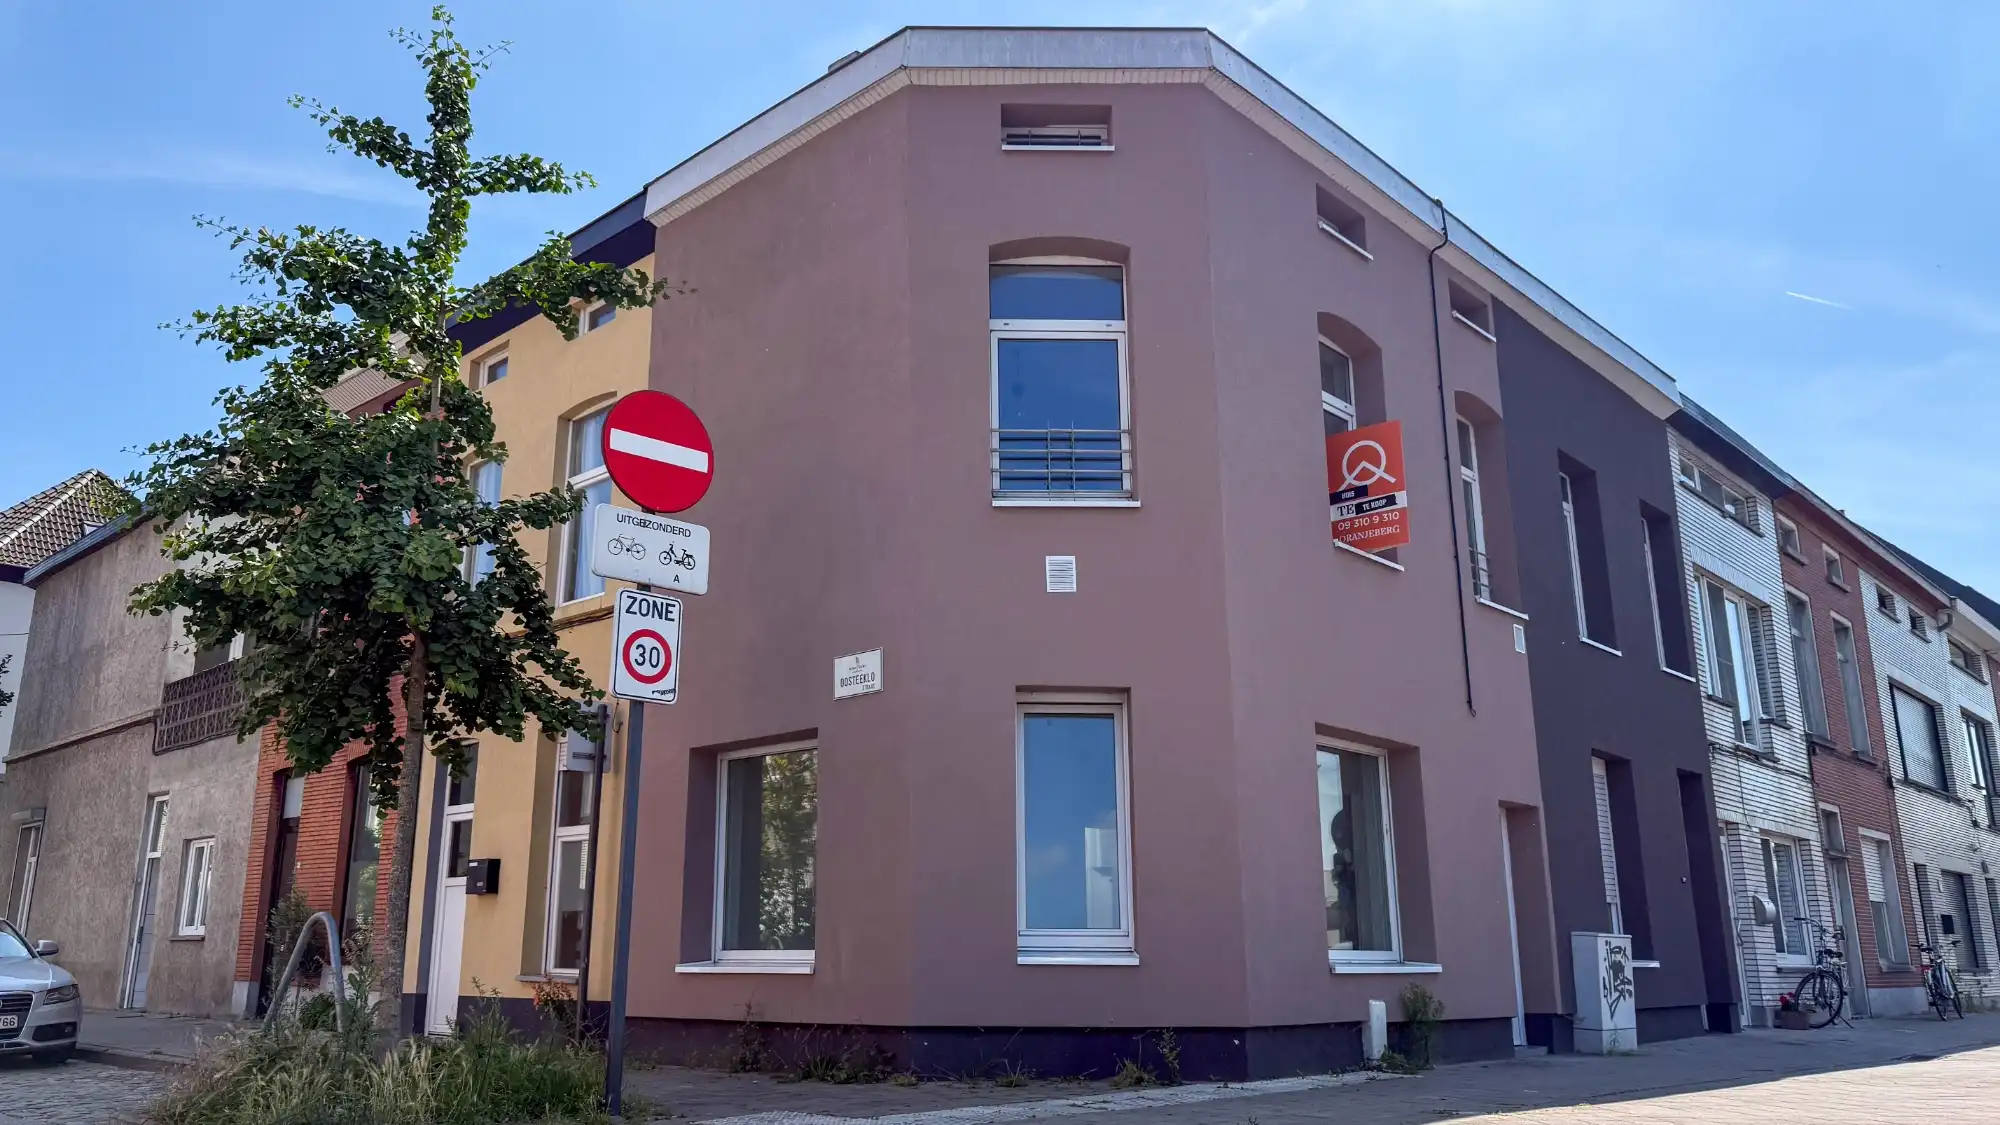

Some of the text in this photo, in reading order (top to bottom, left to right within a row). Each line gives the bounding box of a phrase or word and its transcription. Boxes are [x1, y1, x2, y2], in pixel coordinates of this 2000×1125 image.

[1342, 490, 1355, 500] HUIS
[1337, 503, 1355, 516] TE
[1362, 499, 1387, 511] TE KOOP
[616, 513, 691, 538] UITGEZONDERD
[1337, 511, 1400, 531] 09 310 9 310
[1339, 525, 1400, 542] ORANJEBERG
[673, 574, 681, 584] A
[625, 595, 676, 622] ZONE
[634, 643, 660, 669] 30
[840, 672, 875, 687] OOSTEEKLO
[0, 1017, 16, 1027] 66
